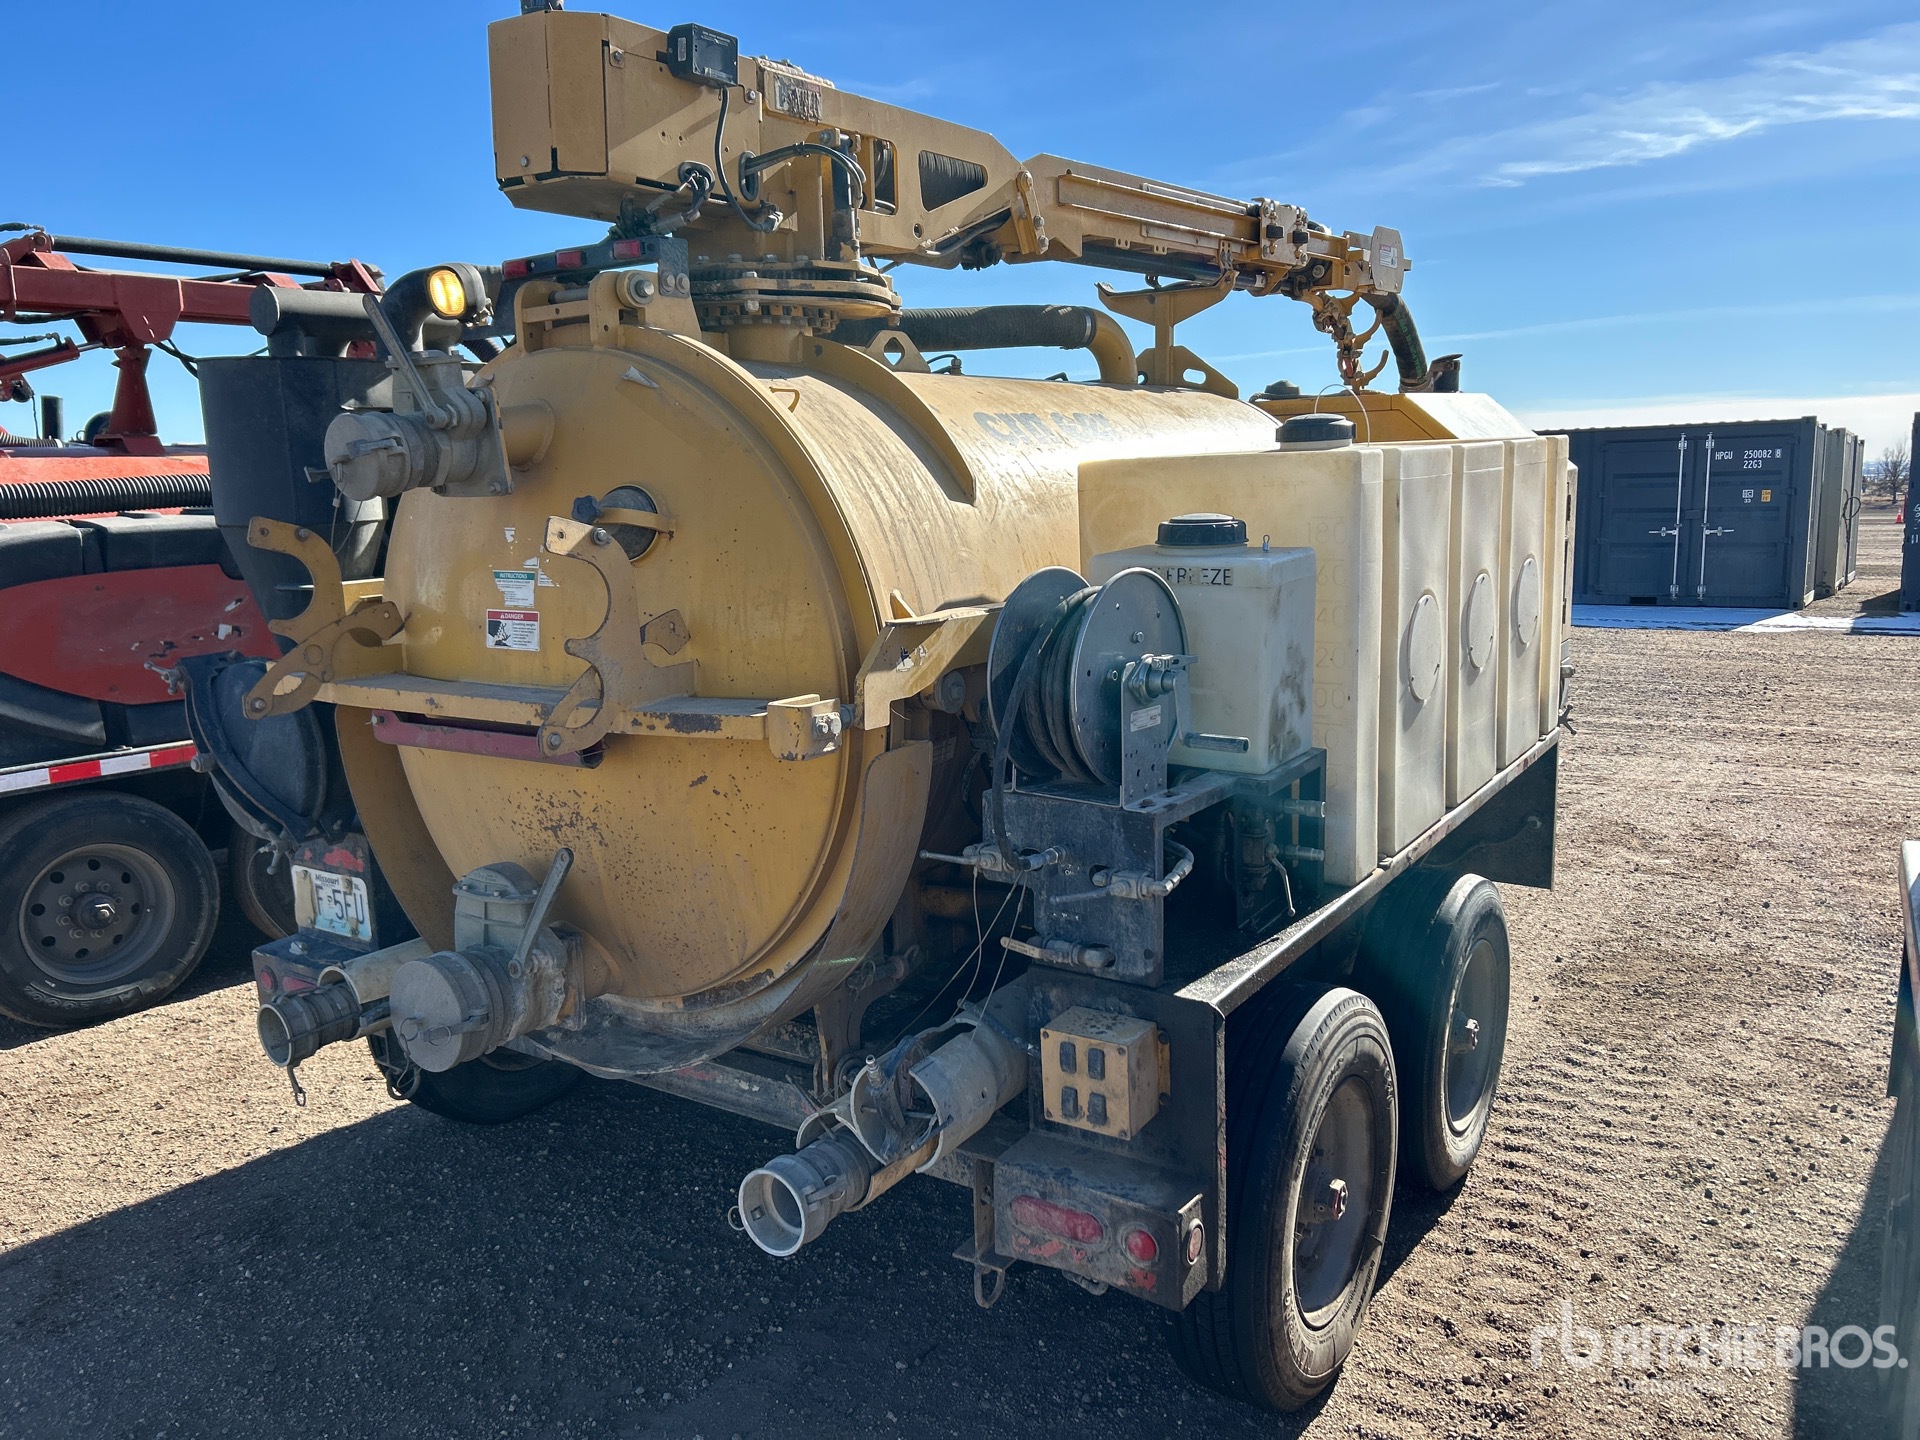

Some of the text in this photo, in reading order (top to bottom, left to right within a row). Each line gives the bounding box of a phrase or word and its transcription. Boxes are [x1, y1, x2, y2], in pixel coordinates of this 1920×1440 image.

[1715, 451, 1733, 460] HPGU
[1743, 449, 1772, 459] 250082
[1743, 460, 1762, 469] 22G3
[315, 873, 340, 886] Missouri
